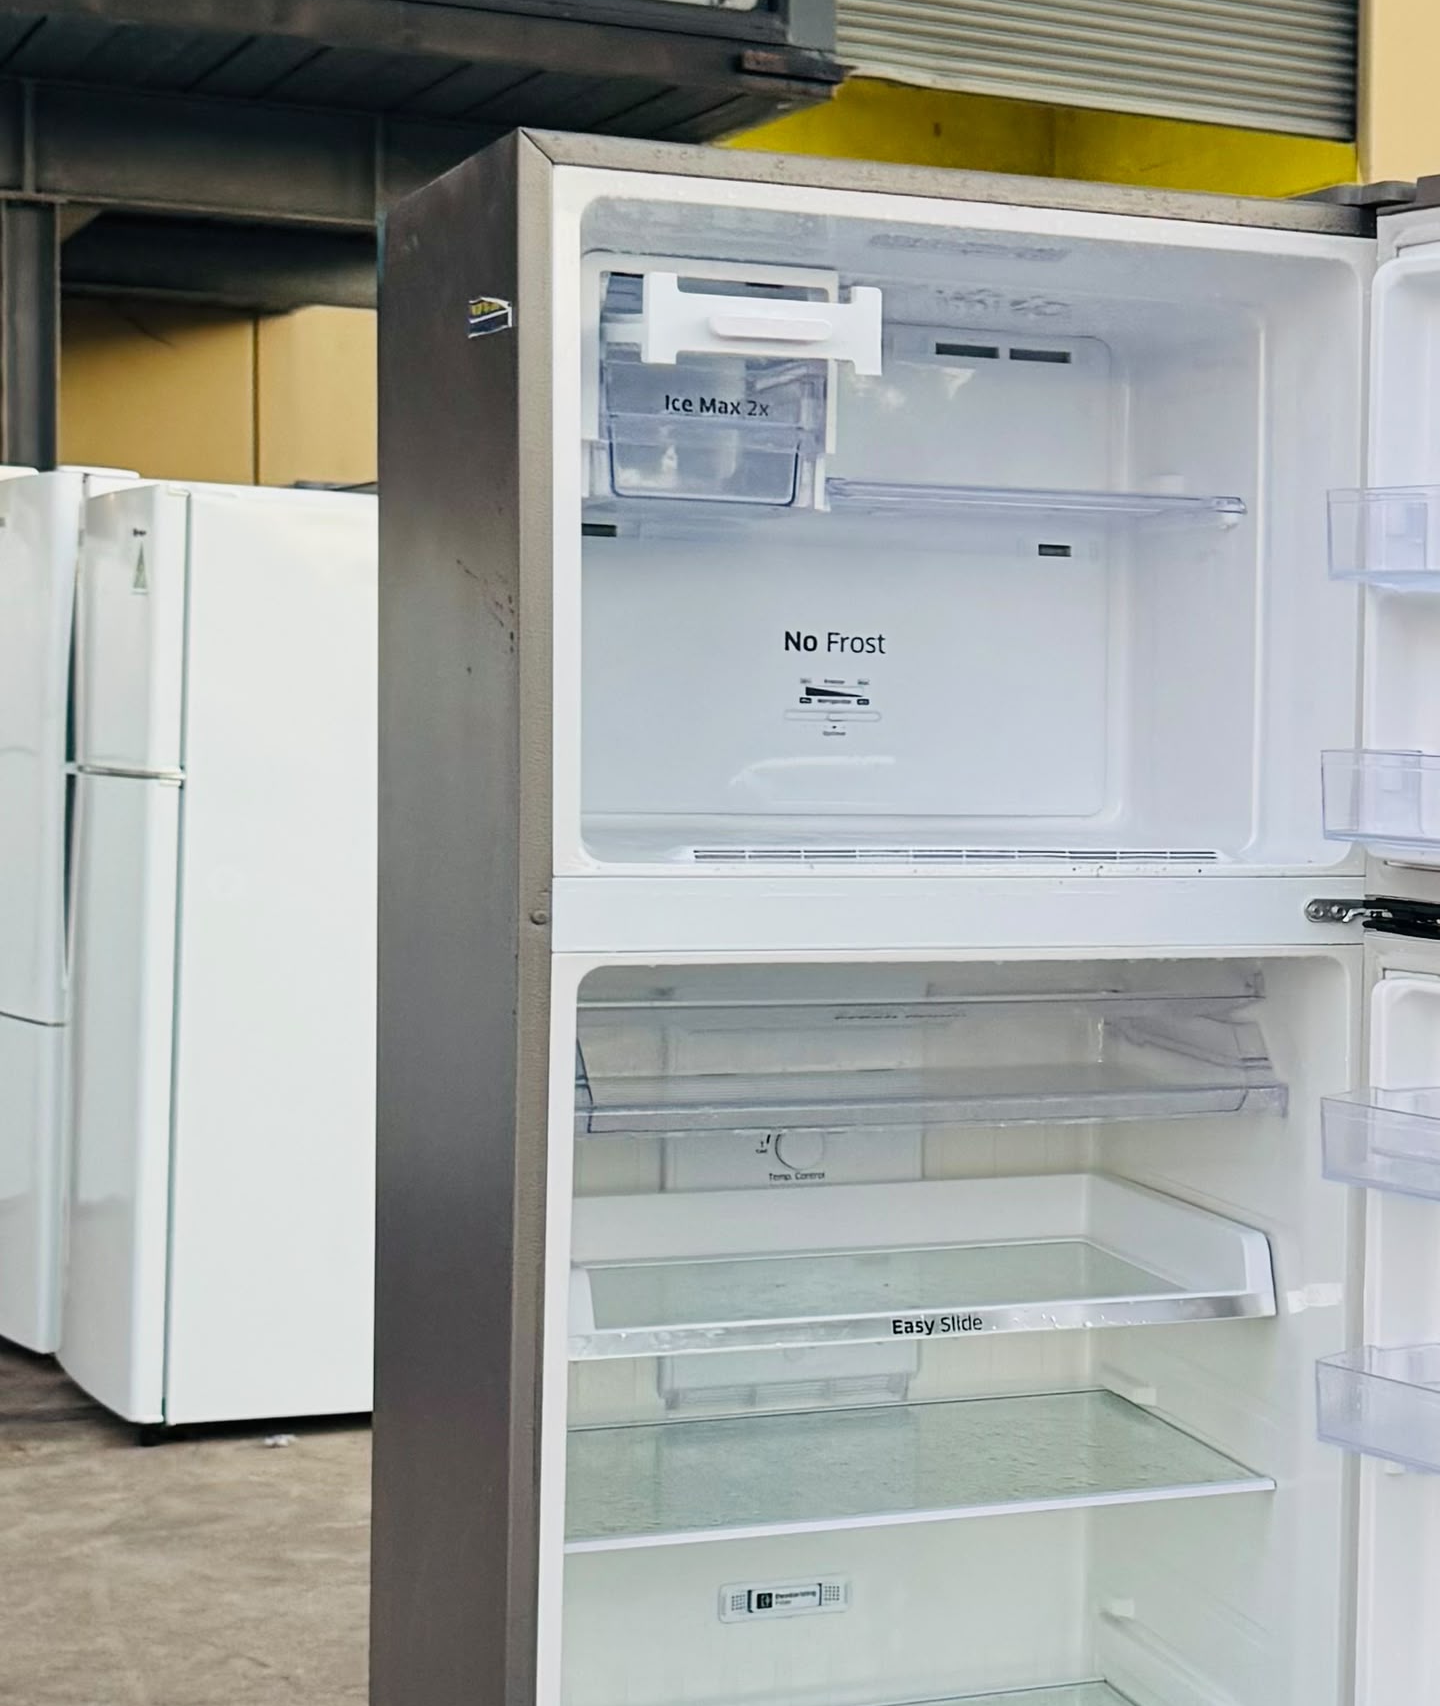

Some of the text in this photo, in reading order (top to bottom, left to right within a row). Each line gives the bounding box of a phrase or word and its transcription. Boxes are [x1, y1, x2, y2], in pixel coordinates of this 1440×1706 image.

[665, 394, 769, 417] Ice Max 2x
[784, 630, 886, 654] No Frost
[794, 1171, 825, 1181] Control
[892, 1314, 983, 1335] Easy Slide
